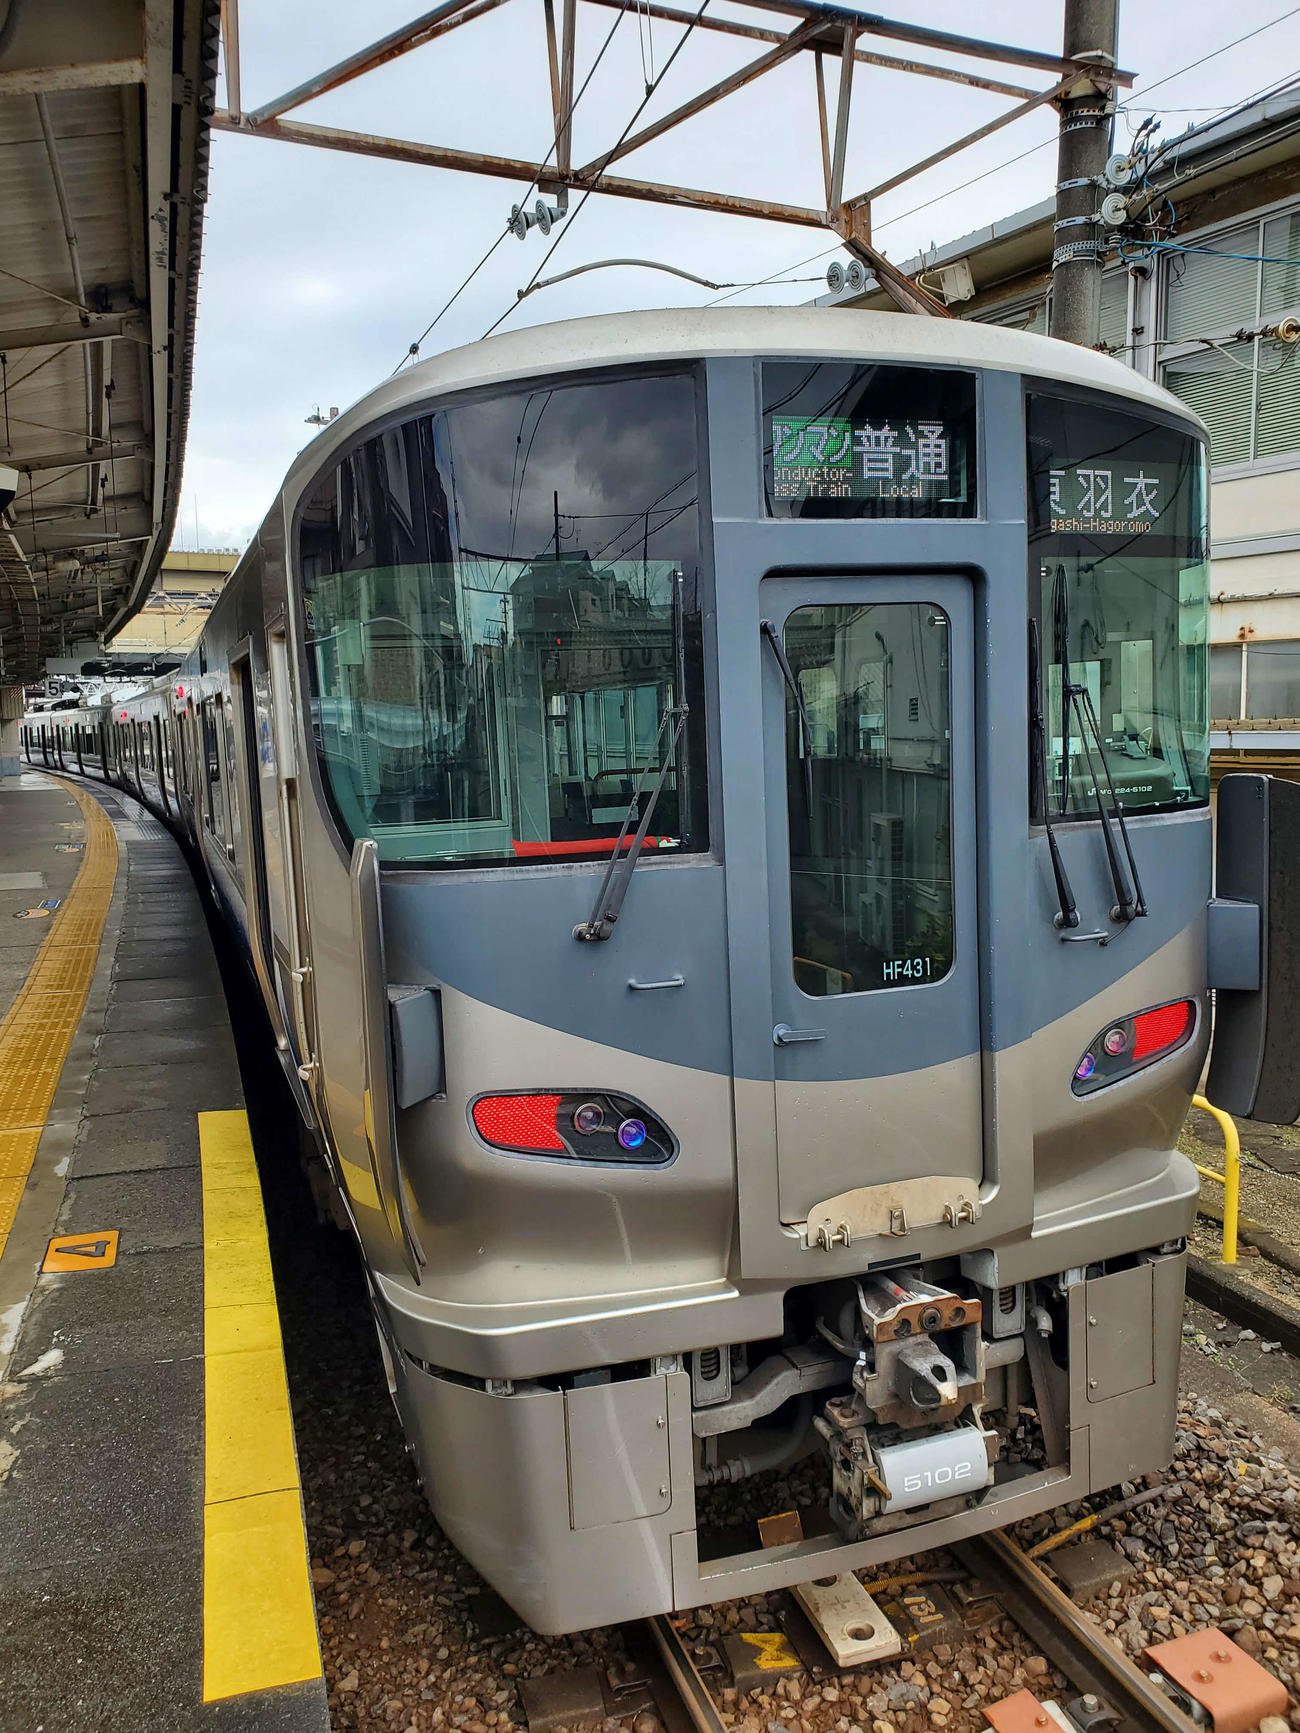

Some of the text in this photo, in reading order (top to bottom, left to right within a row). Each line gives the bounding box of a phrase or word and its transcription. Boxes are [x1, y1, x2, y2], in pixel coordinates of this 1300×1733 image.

[853, 418, 949, 480] 普通
[806, 481, 852, 497] Train
[879, 480, 923, 497] Local
[48, 681, 59, 696] 5
[882, 957, 931, 981] HF431
[904, 1461, 972, 1493] 5102
